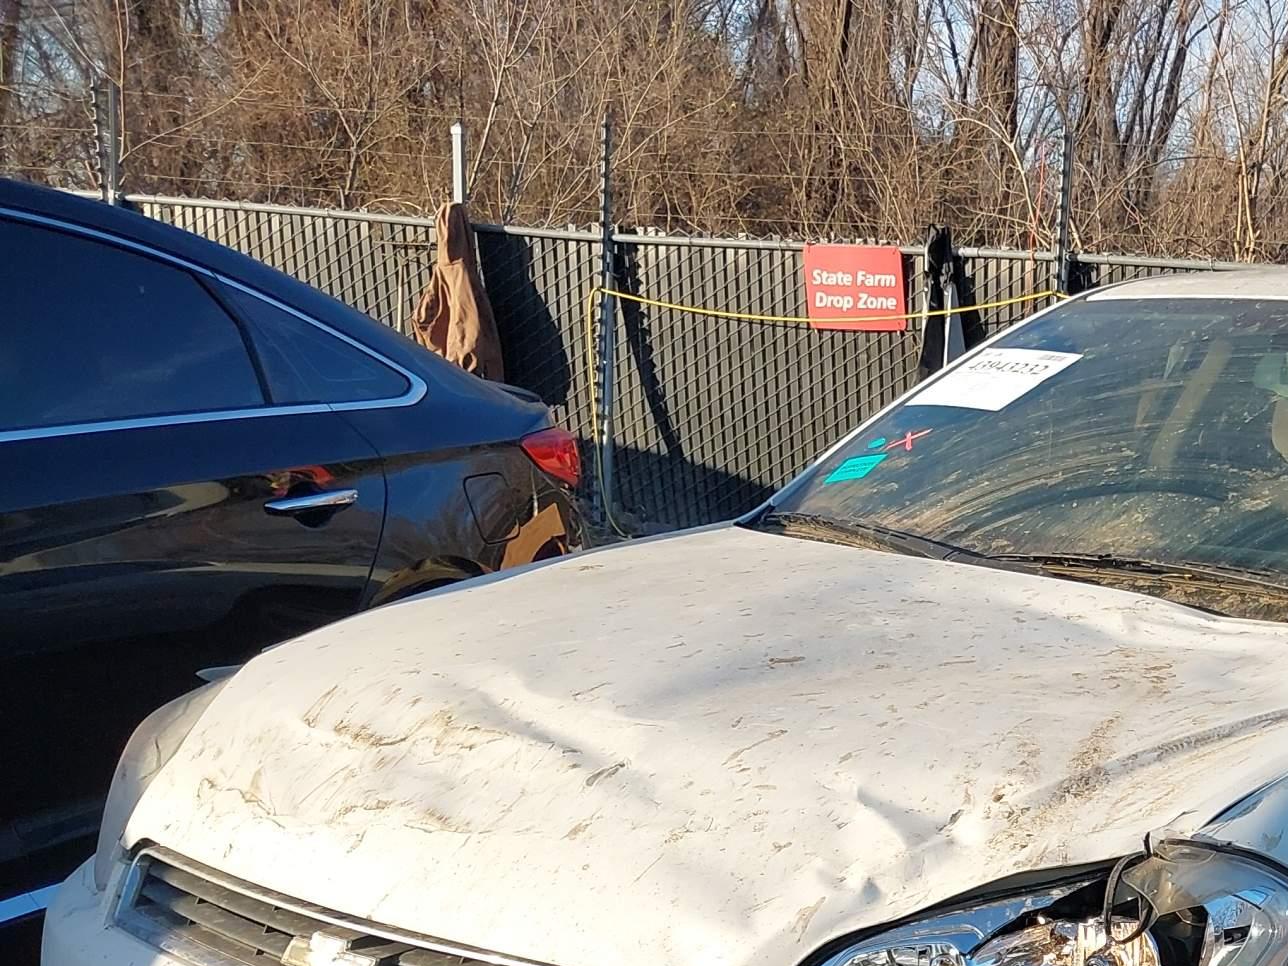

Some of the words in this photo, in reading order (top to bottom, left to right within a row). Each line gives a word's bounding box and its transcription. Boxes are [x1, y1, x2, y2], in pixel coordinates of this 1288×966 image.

[812, 269, 853, 286] State
[856, 270, 897, 288] Farm
[815, 291, 854, 312] Drop
[857, 293, 898, 310] Zone
